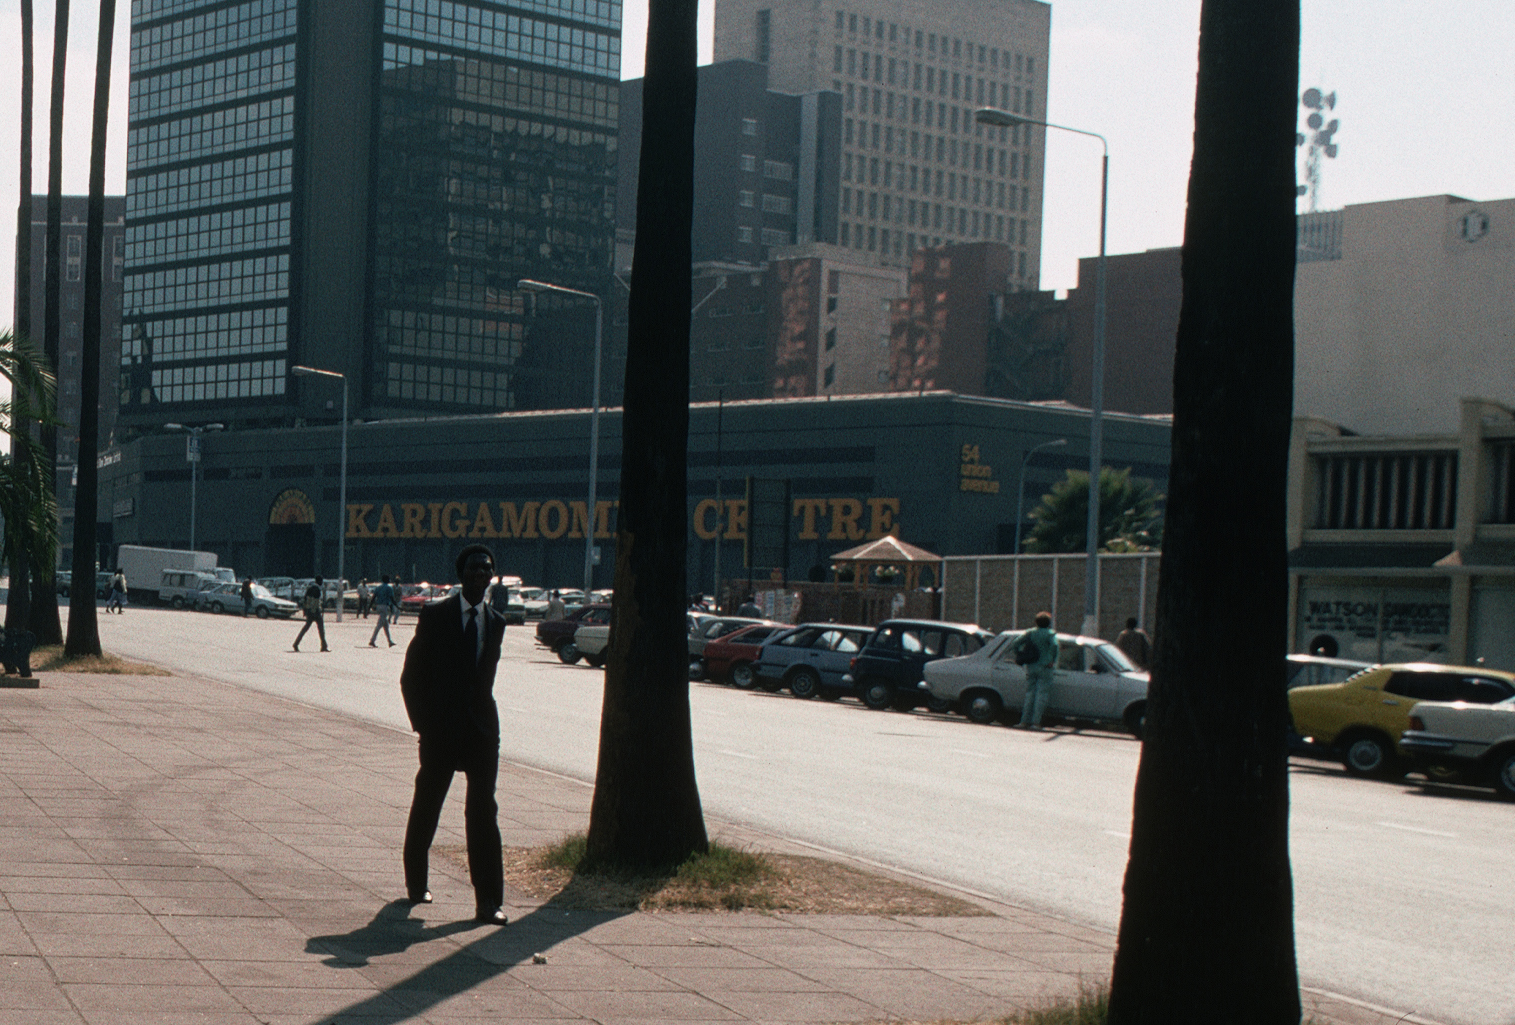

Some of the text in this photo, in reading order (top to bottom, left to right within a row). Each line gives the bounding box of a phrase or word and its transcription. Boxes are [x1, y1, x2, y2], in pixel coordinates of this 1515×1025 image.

[962, 444, 979, 465] 54
[344, 497, 900, 540] KARIGAMOM CETRE
[1309, 601, 1379, 617] WATSON
